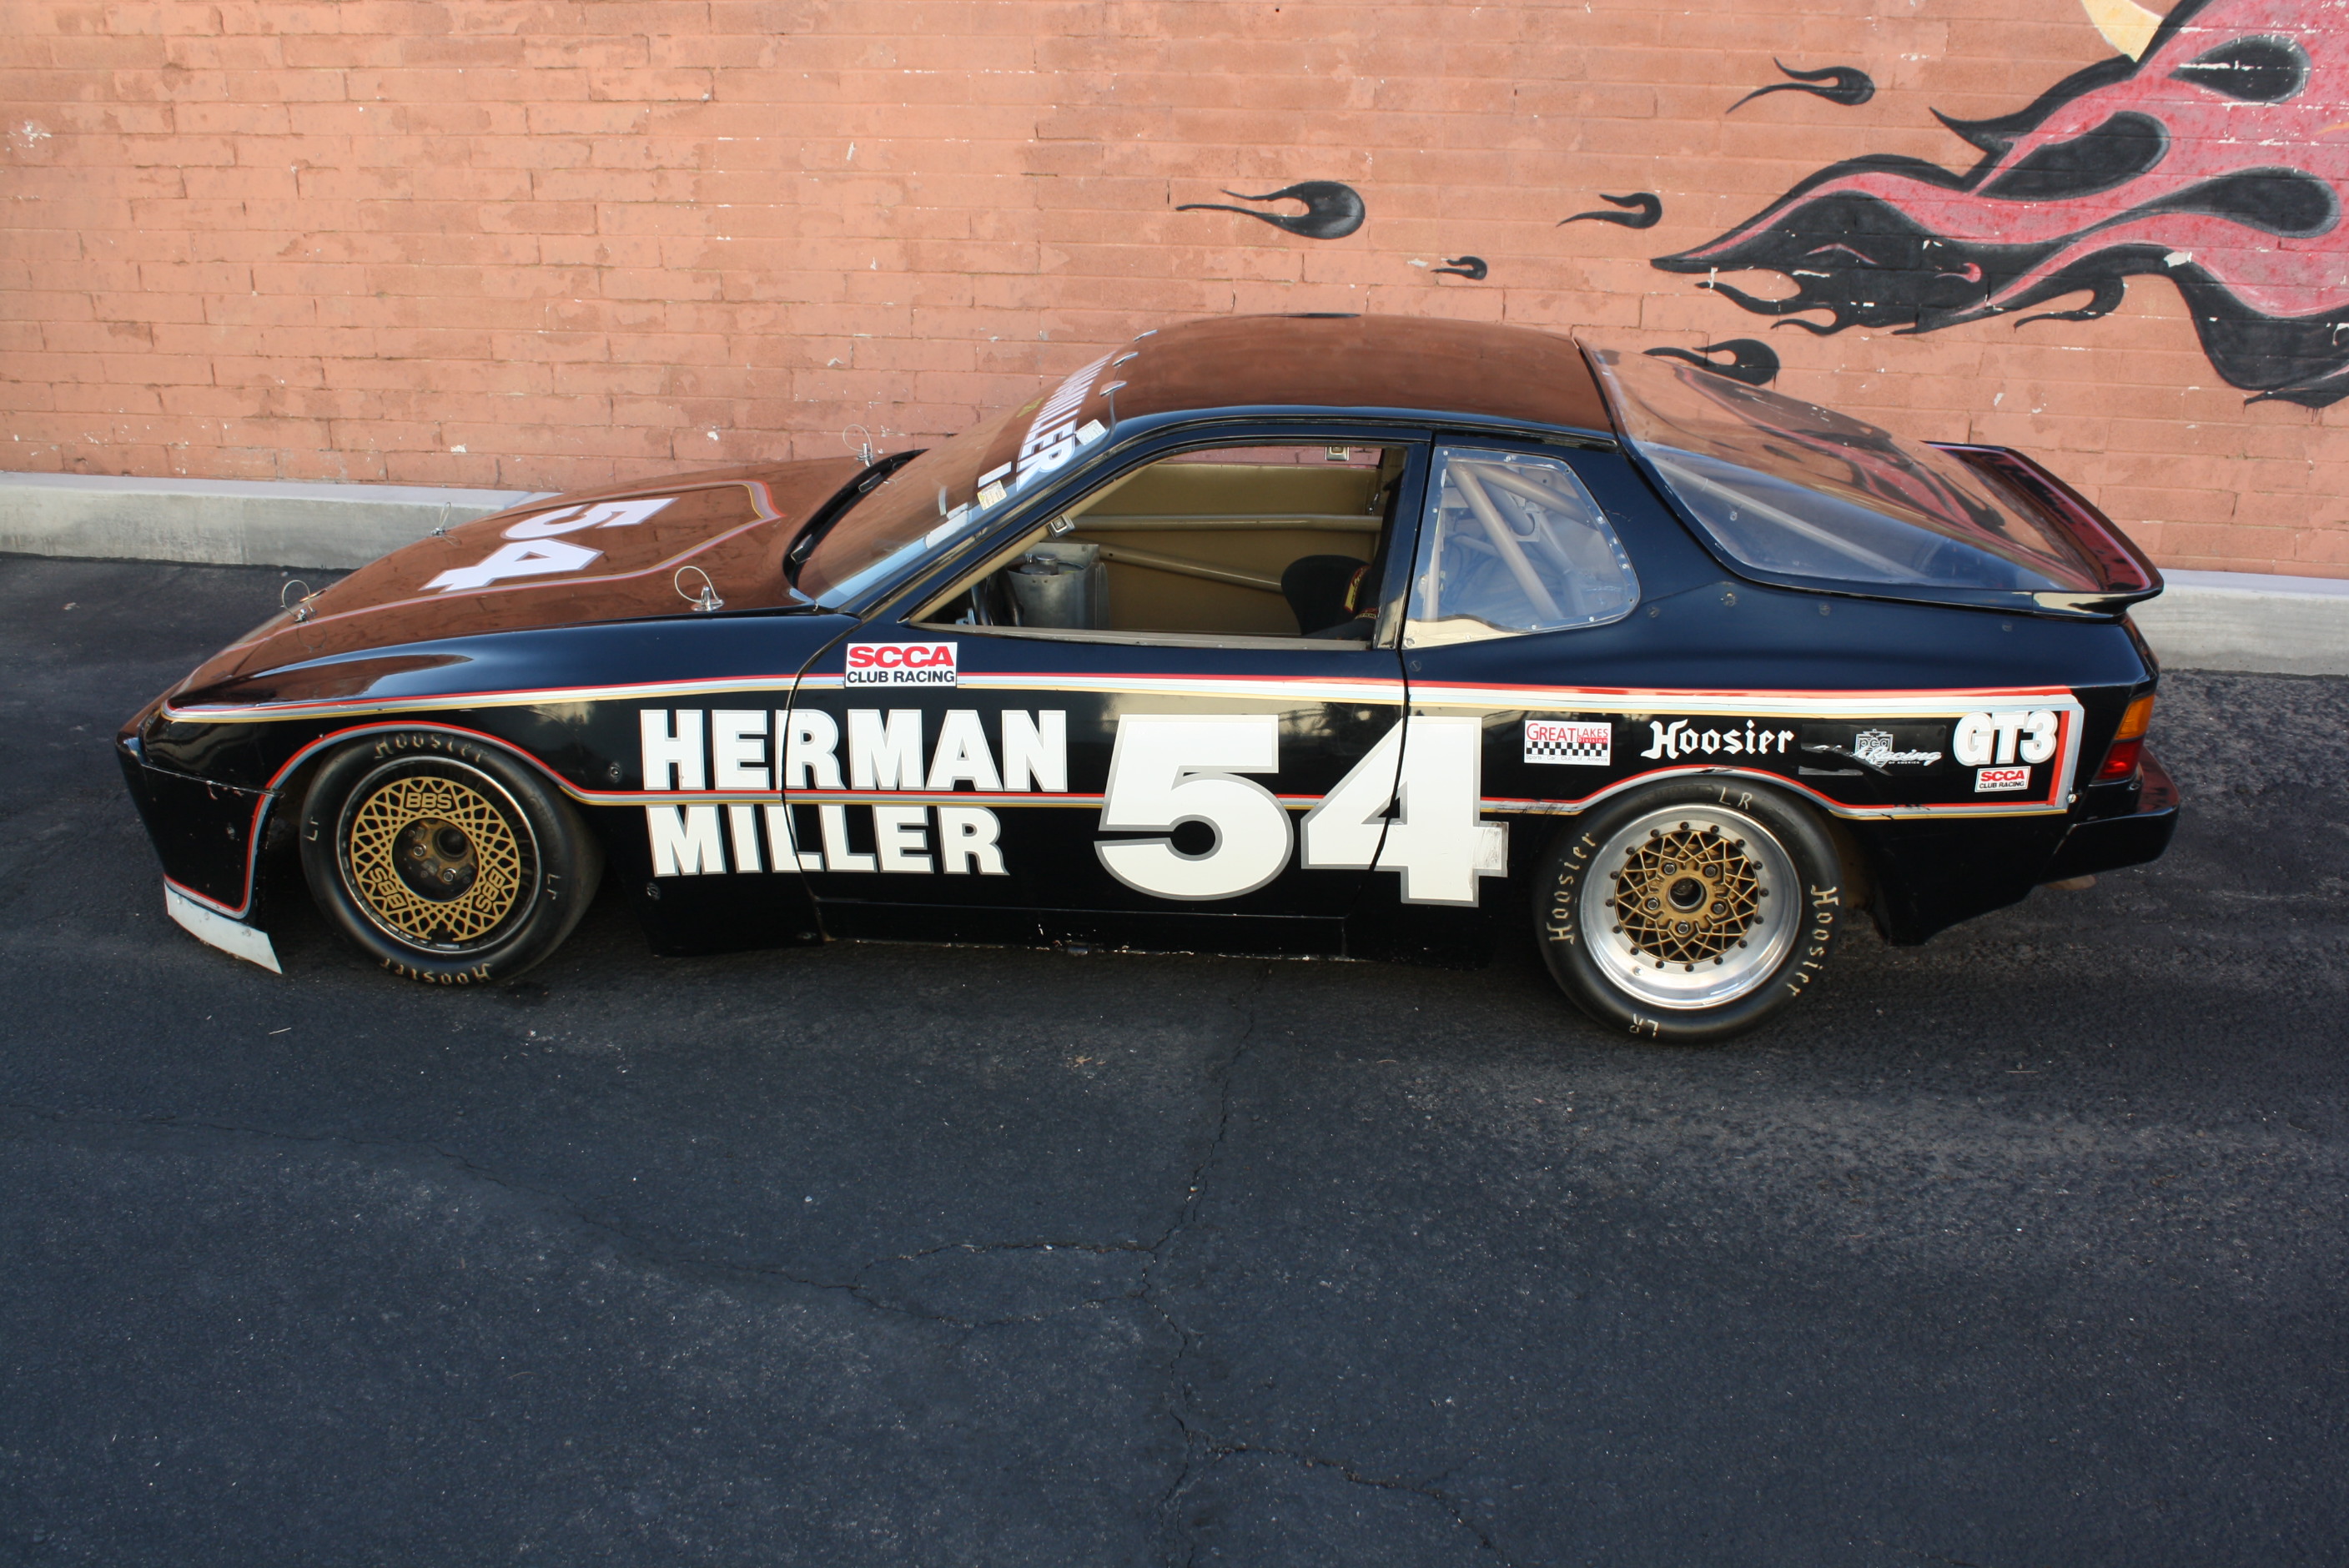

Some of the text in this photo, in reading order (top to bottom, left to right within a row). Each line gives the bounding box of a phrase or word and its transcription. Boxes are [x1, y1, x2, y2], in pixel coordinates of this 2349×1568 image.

[419, 498, 679, 592] 54
[847, 670, 955, 683] CLUB RACING
[848, 646, 954, 668] SCCA
[640, 709, 1069, 792] HERMAN
[1527, 722, 1608, 742] GREAT LAKES
[1640, 718, 1795, 760] Hoosier
[1953, 708, 2059, 766] GT3
[1864, 745, 1943, 766] Racing
[1980, 770, 2025, 782] SCCA
[405, 792, 453, 810] BBS
[1094, 714, 1509, 907] 54
[1718, 787, 1752, 810] LR
[646, 803, 1010, 877] MILLER
[369, 867, 407, 910] BBS
[475, 868, 506, 912] BBS
[1546, 832, 1596, 945] Hoosier
[1786, 884, 1839, 997] Hoosier
